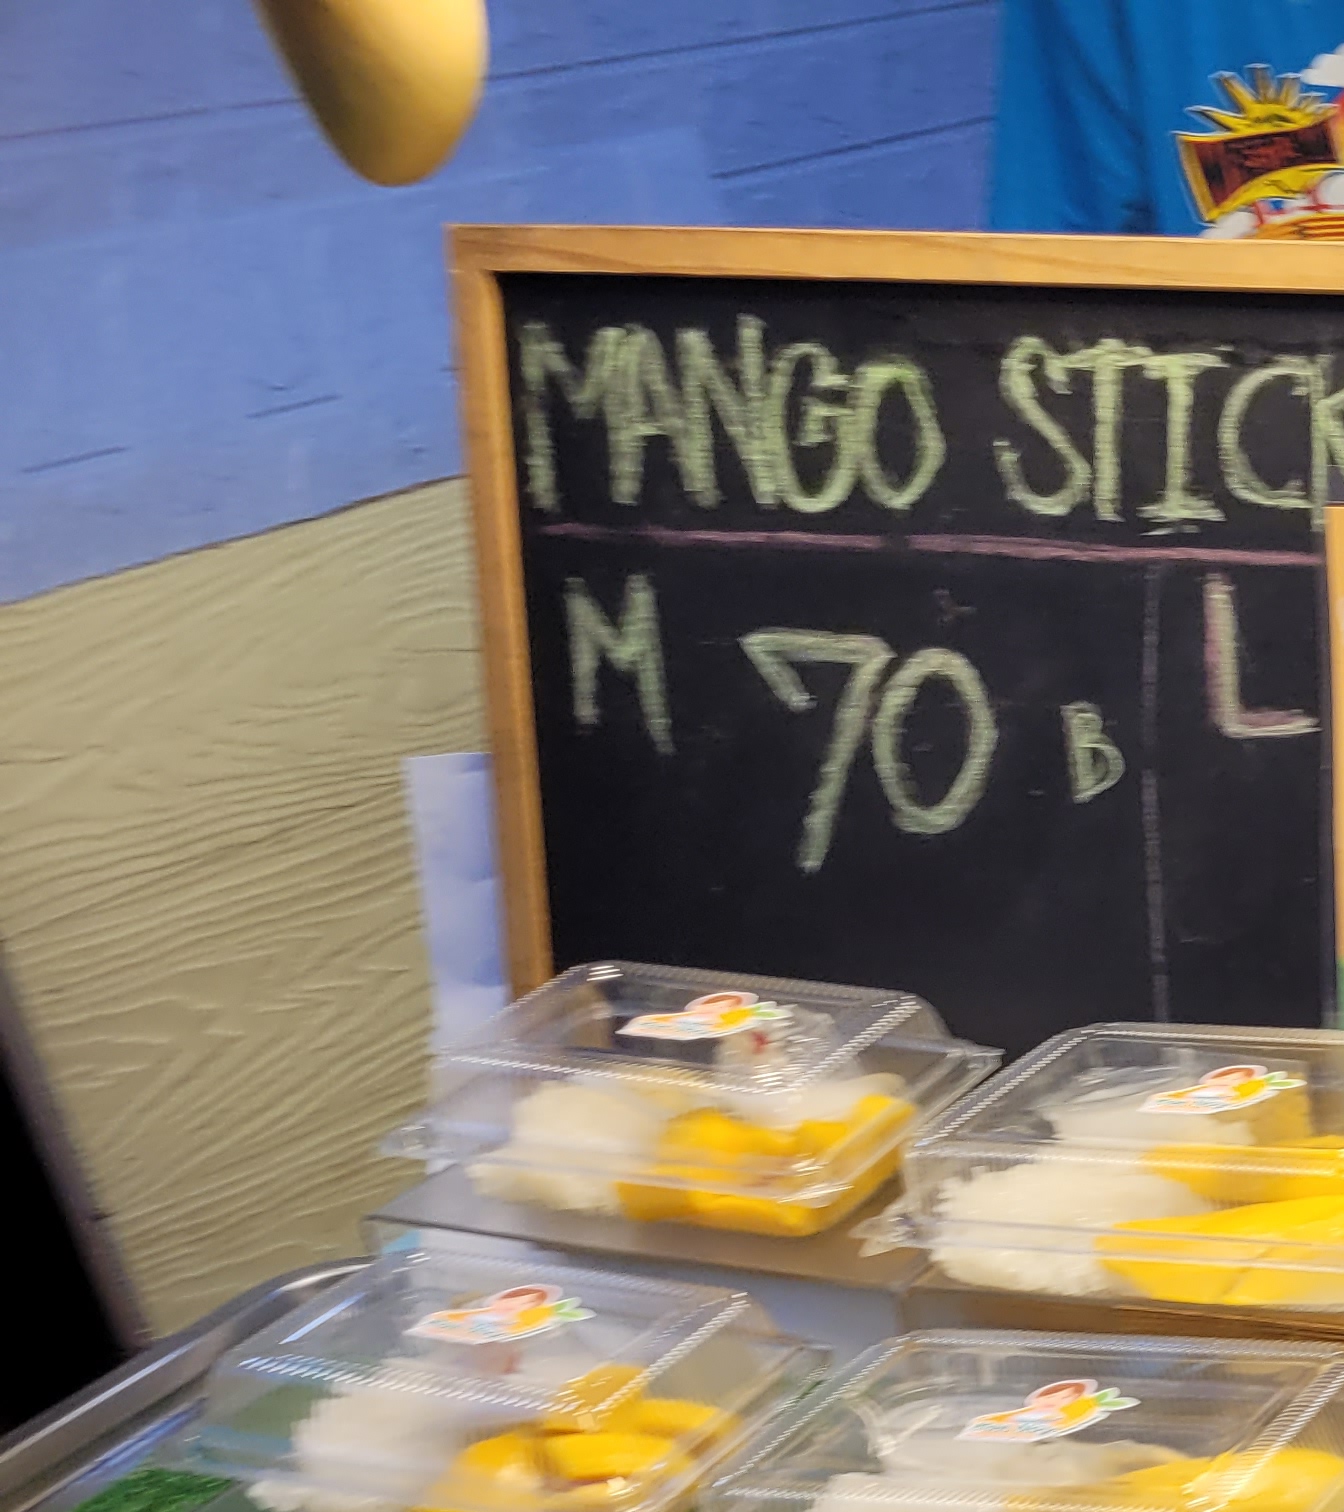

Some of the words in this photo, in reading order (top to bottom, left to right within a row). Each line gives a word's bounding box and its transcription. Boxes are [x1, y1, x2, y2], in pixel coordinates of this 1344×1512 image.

[521, 311, 946, 514] MANGO
[565, 574, 674, 756] M
[739, 628, 998, 873] 70
[1060, 702, 1124, 804] B
[1203, 574, 1320, 739] L
